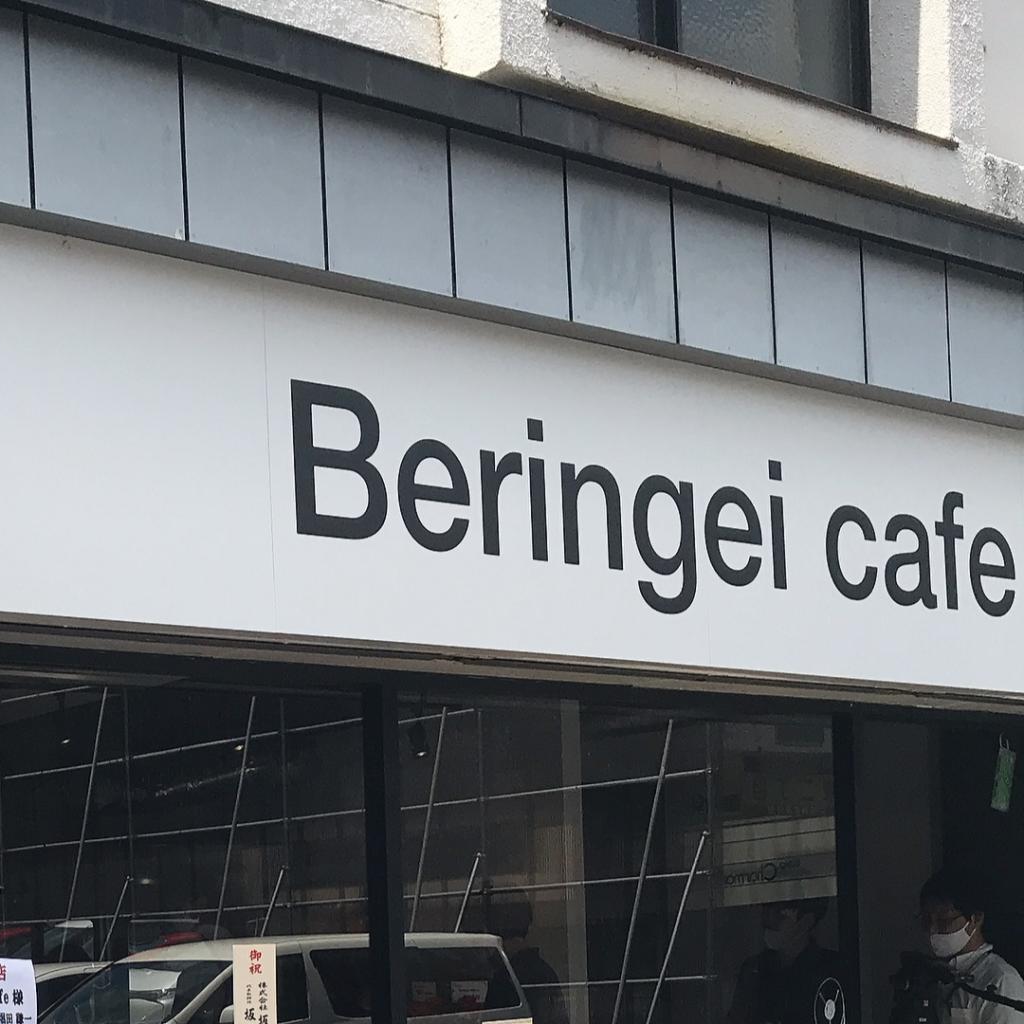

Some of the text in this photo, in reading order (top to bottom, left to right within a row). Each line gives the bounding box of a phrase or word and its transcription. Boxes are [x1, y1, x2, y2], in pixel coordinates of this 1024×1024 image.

[290, 379, 1015, 617] Beringei cafe
[249, 949, 262, 974] 御祝
